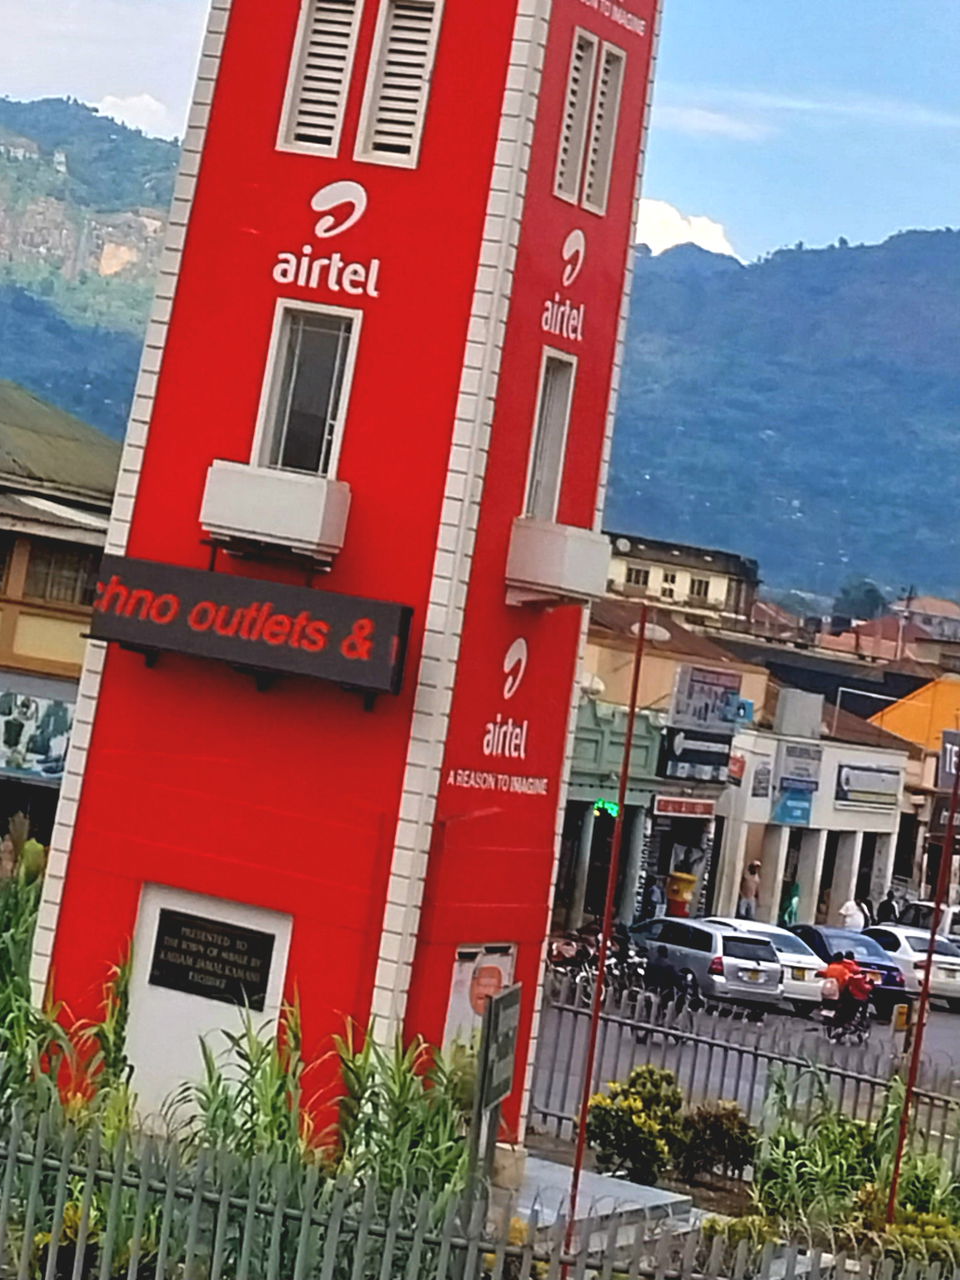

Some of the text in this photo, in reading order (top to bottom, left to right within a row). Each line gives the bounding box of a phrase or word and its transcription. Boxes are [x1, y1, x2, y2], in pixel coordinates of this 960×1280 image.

[273, 244, 380, 298] airtel
[541, 291, 585, 341] airtel
[187, 600, 330, 652] outlets
[341, 618, 375, 660] &
[483, 713, 528, 760] airtel
[447, 770, 454, 785] A
[456, 769, 496, 790] REASON
[497, 774, 509, 792] TO
